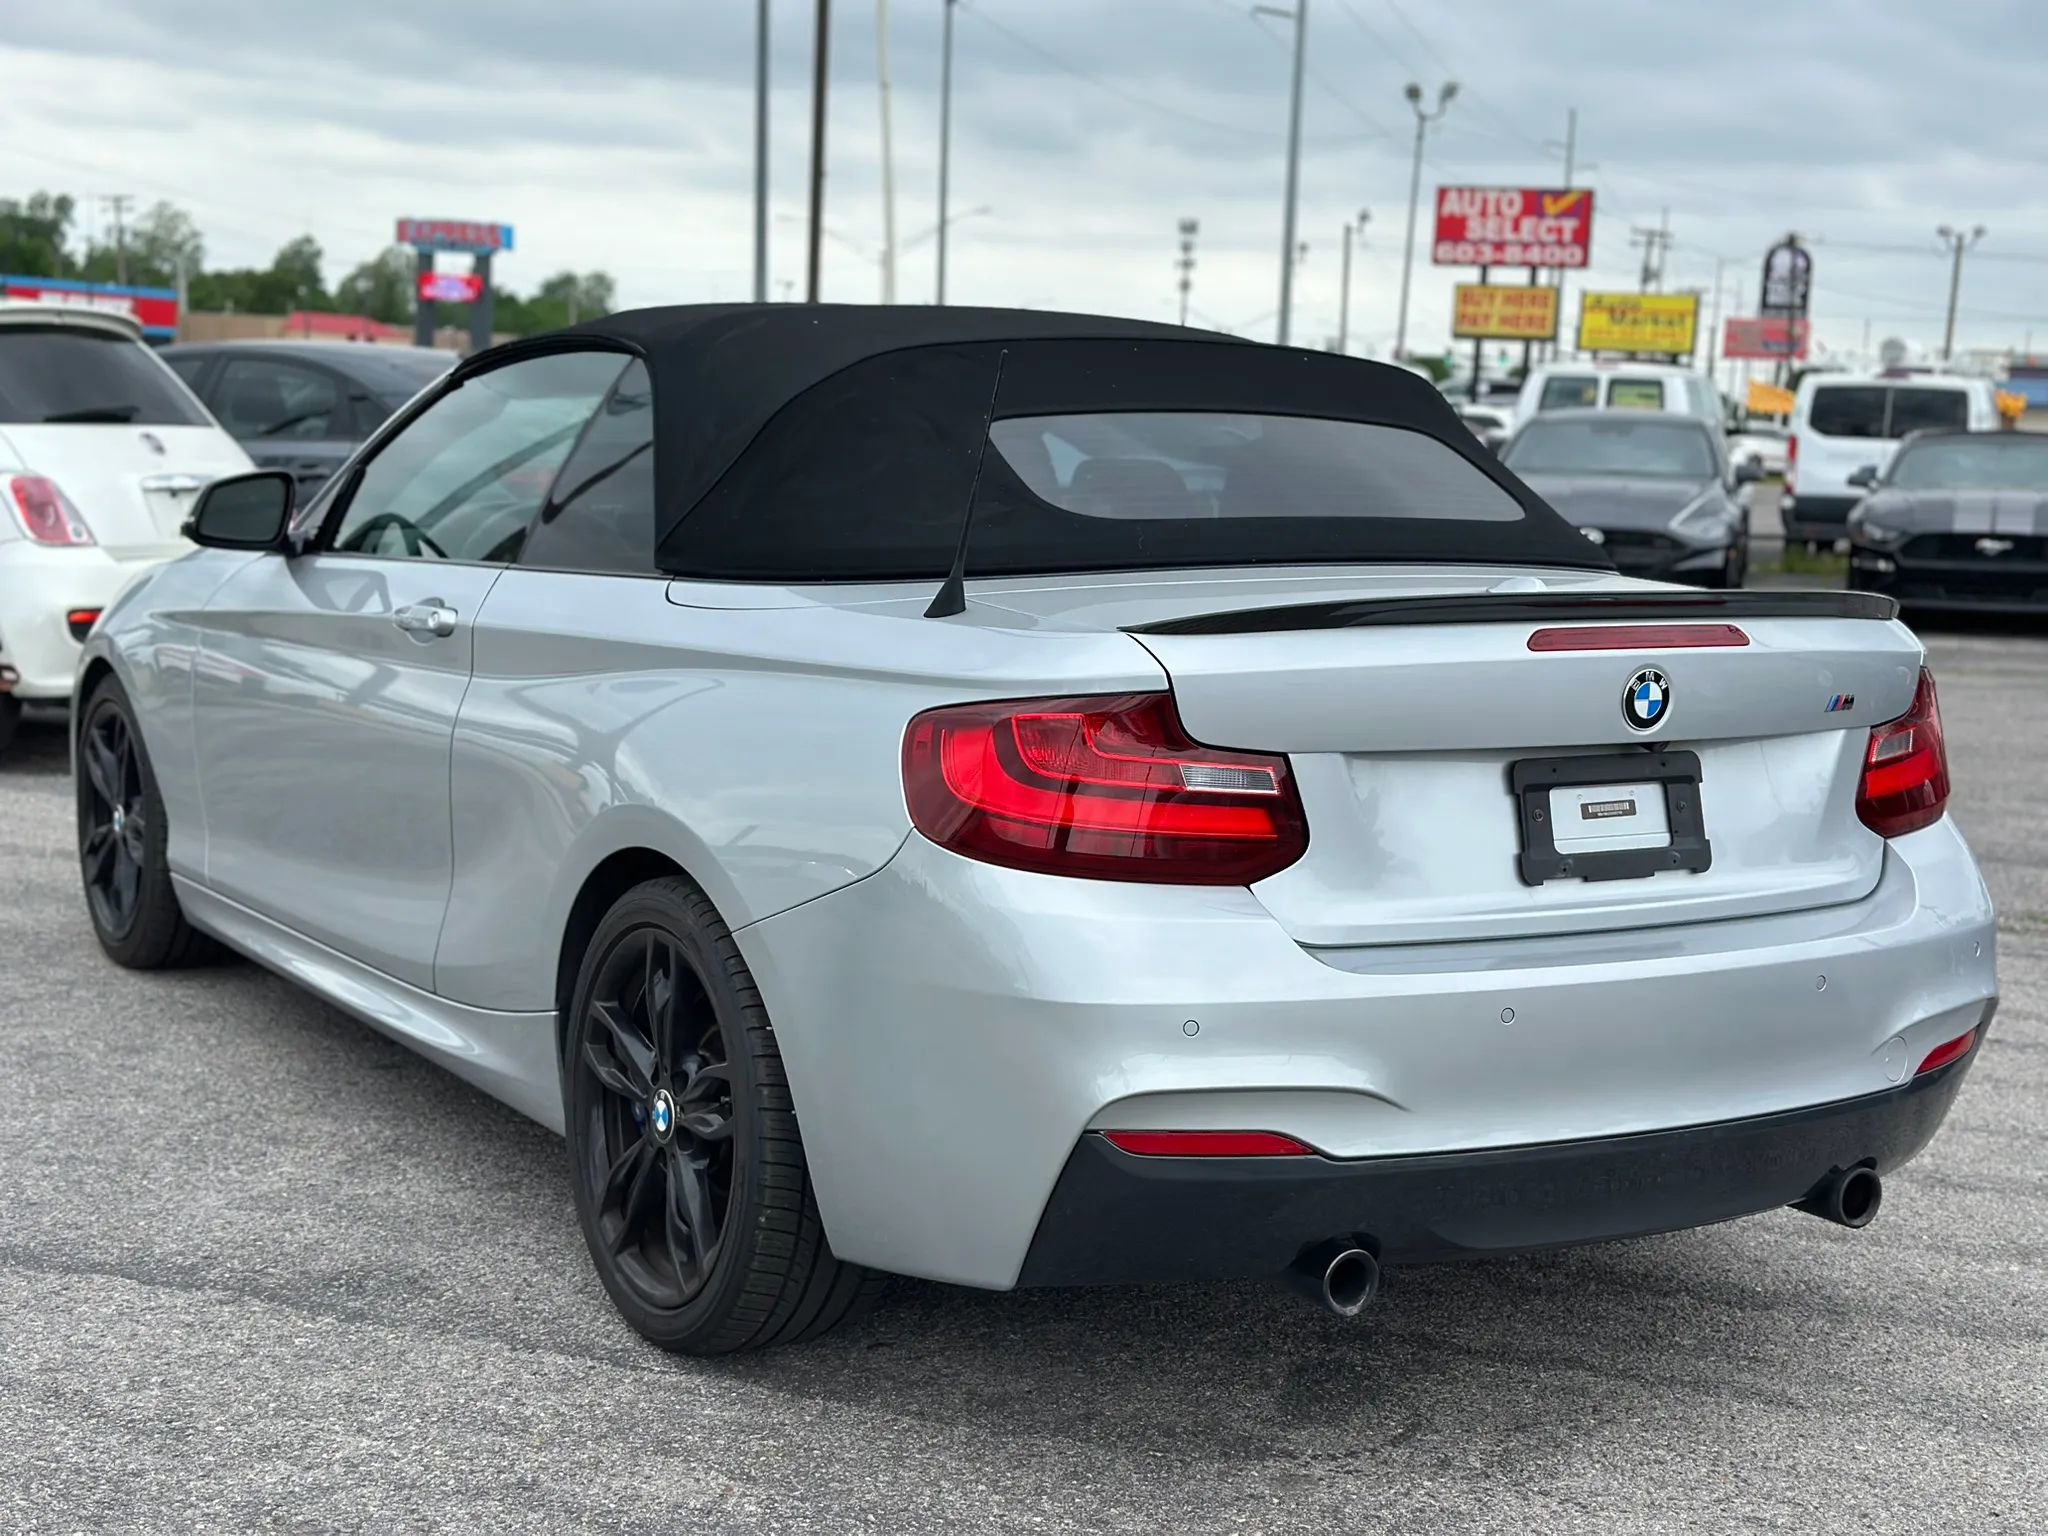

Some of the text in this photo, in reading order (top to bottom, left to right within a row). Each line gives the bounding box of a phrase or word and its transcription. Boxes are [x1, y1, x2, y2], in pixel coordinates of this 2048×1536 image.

[1441, 190, 1522, 217] AUTO
[1465, 217, 1579, 242] SELECT
[1462, 291, 1549, 310] BUY HERE
[1460, 312, 1547, 332] PAY HERE
[1631, 671, 1668, 691] BMW
